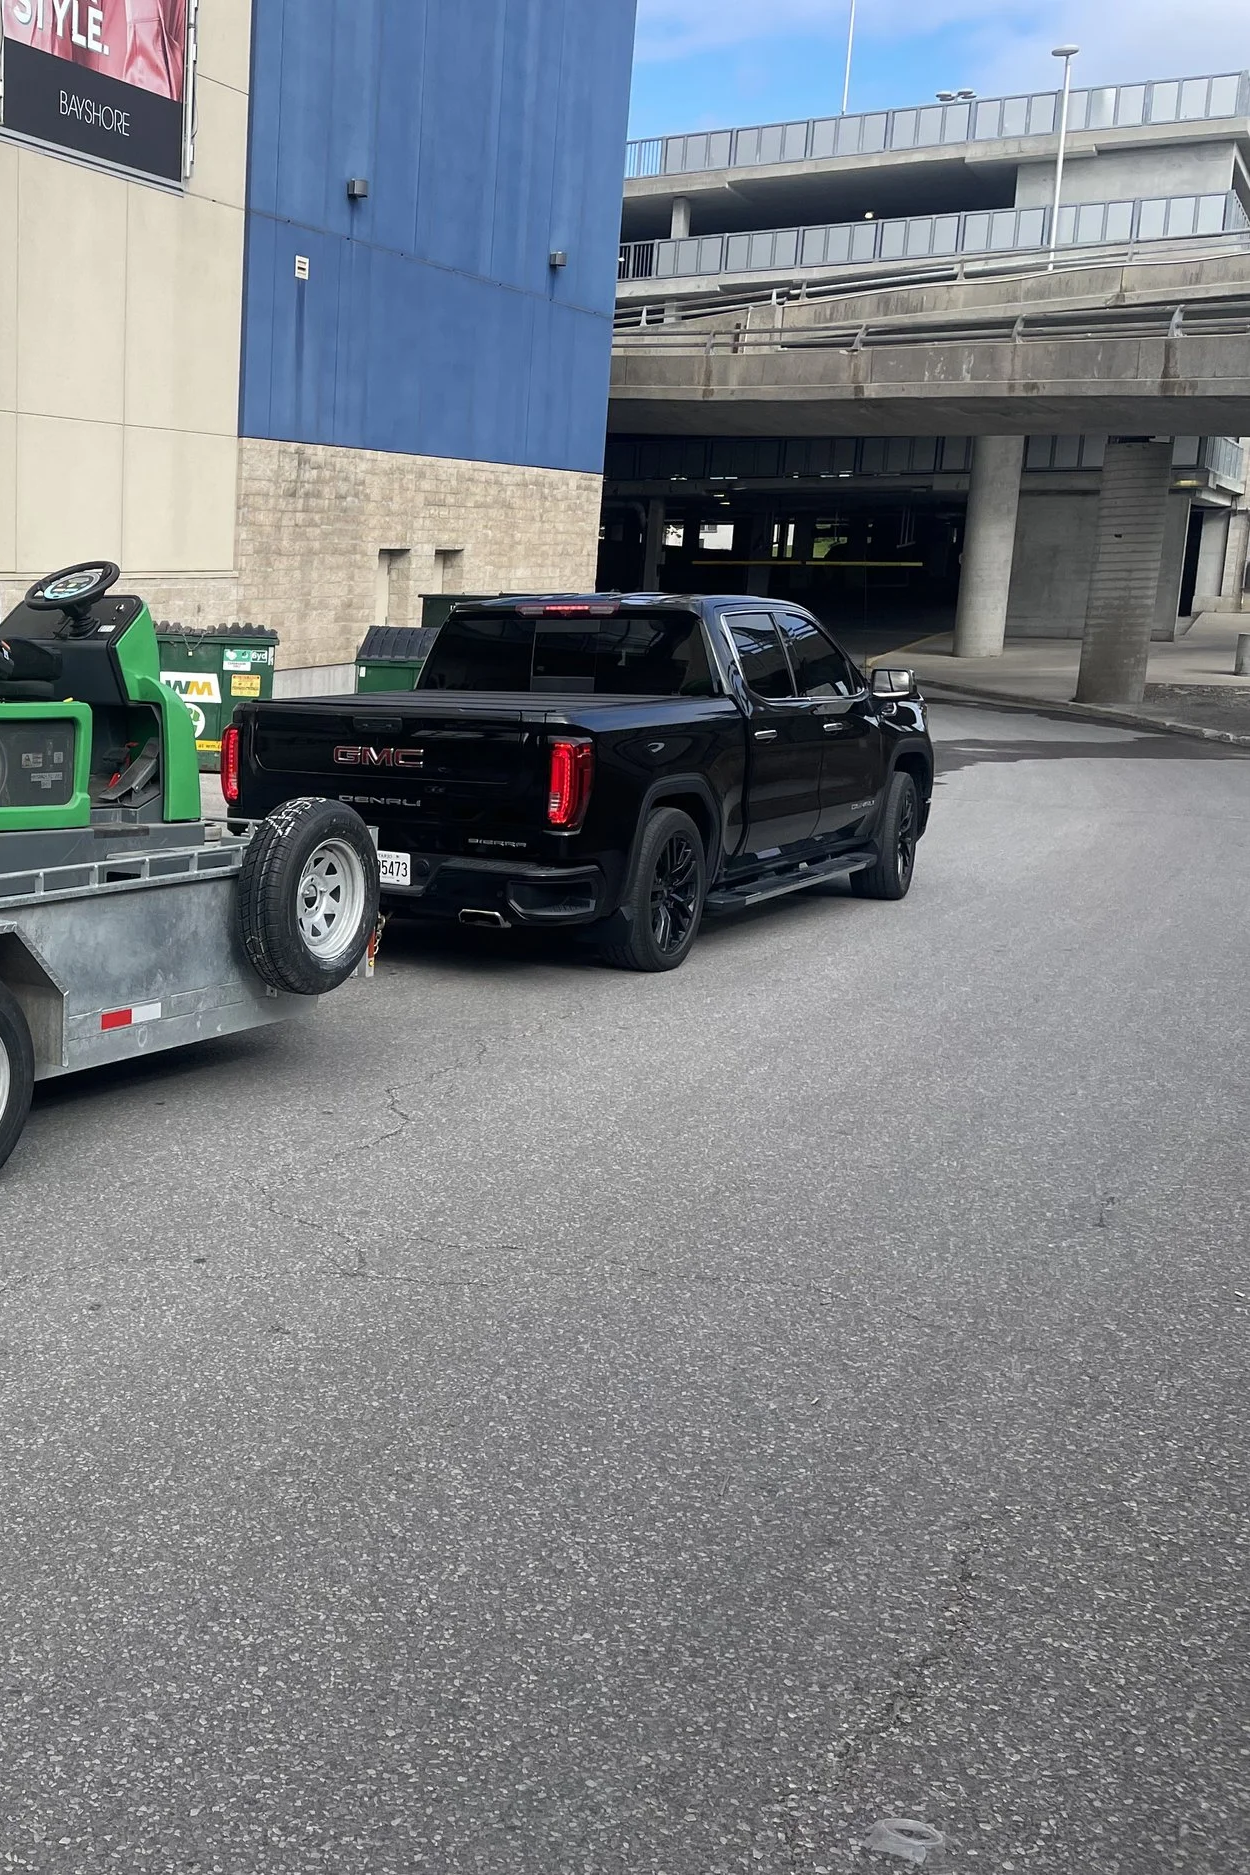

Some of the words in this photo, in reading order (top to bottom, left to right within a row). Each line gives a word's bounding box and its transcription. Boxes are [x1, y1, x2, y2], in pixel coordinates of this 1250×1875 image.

[59, 90, 130, 136] BAYSHORE
[165, 680, 213, 696] WM
[333, 745, 424, 768] GMC
[339, 794, 421, 807] DENALI
[468, 838, 526, 848] SIERRA
